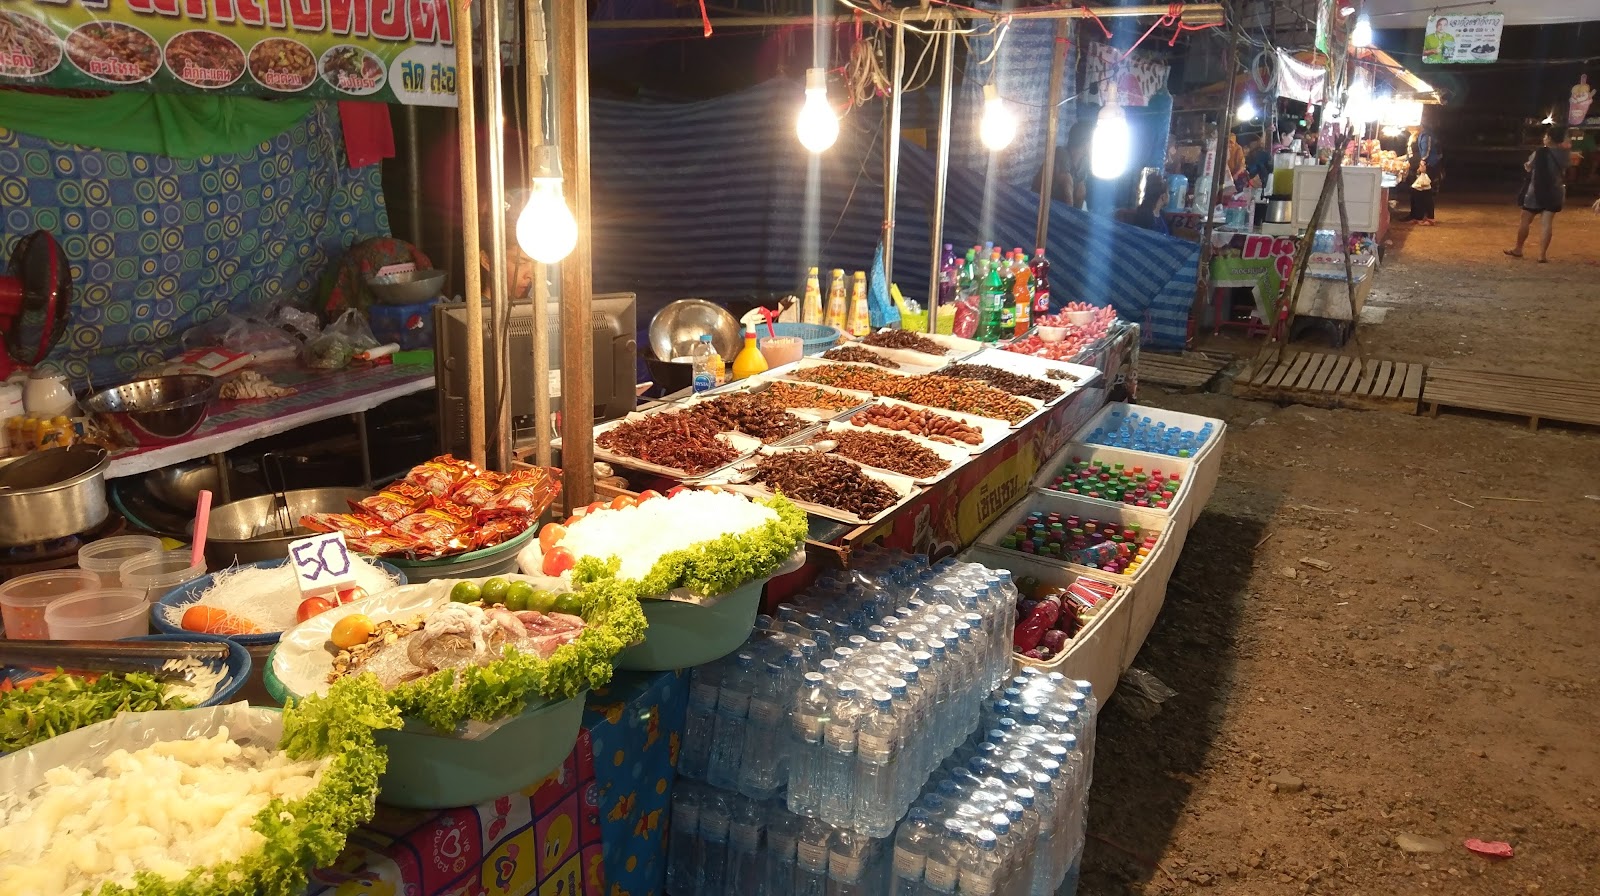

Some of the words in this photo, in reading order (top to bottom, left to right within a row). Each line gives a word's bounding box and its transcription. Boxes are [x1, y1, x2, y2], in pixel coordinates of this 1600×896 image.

[401, 60, 425, 92] สด
[430, 62, 457, 95] สะอ
[292, 537, 350, 581] 50
